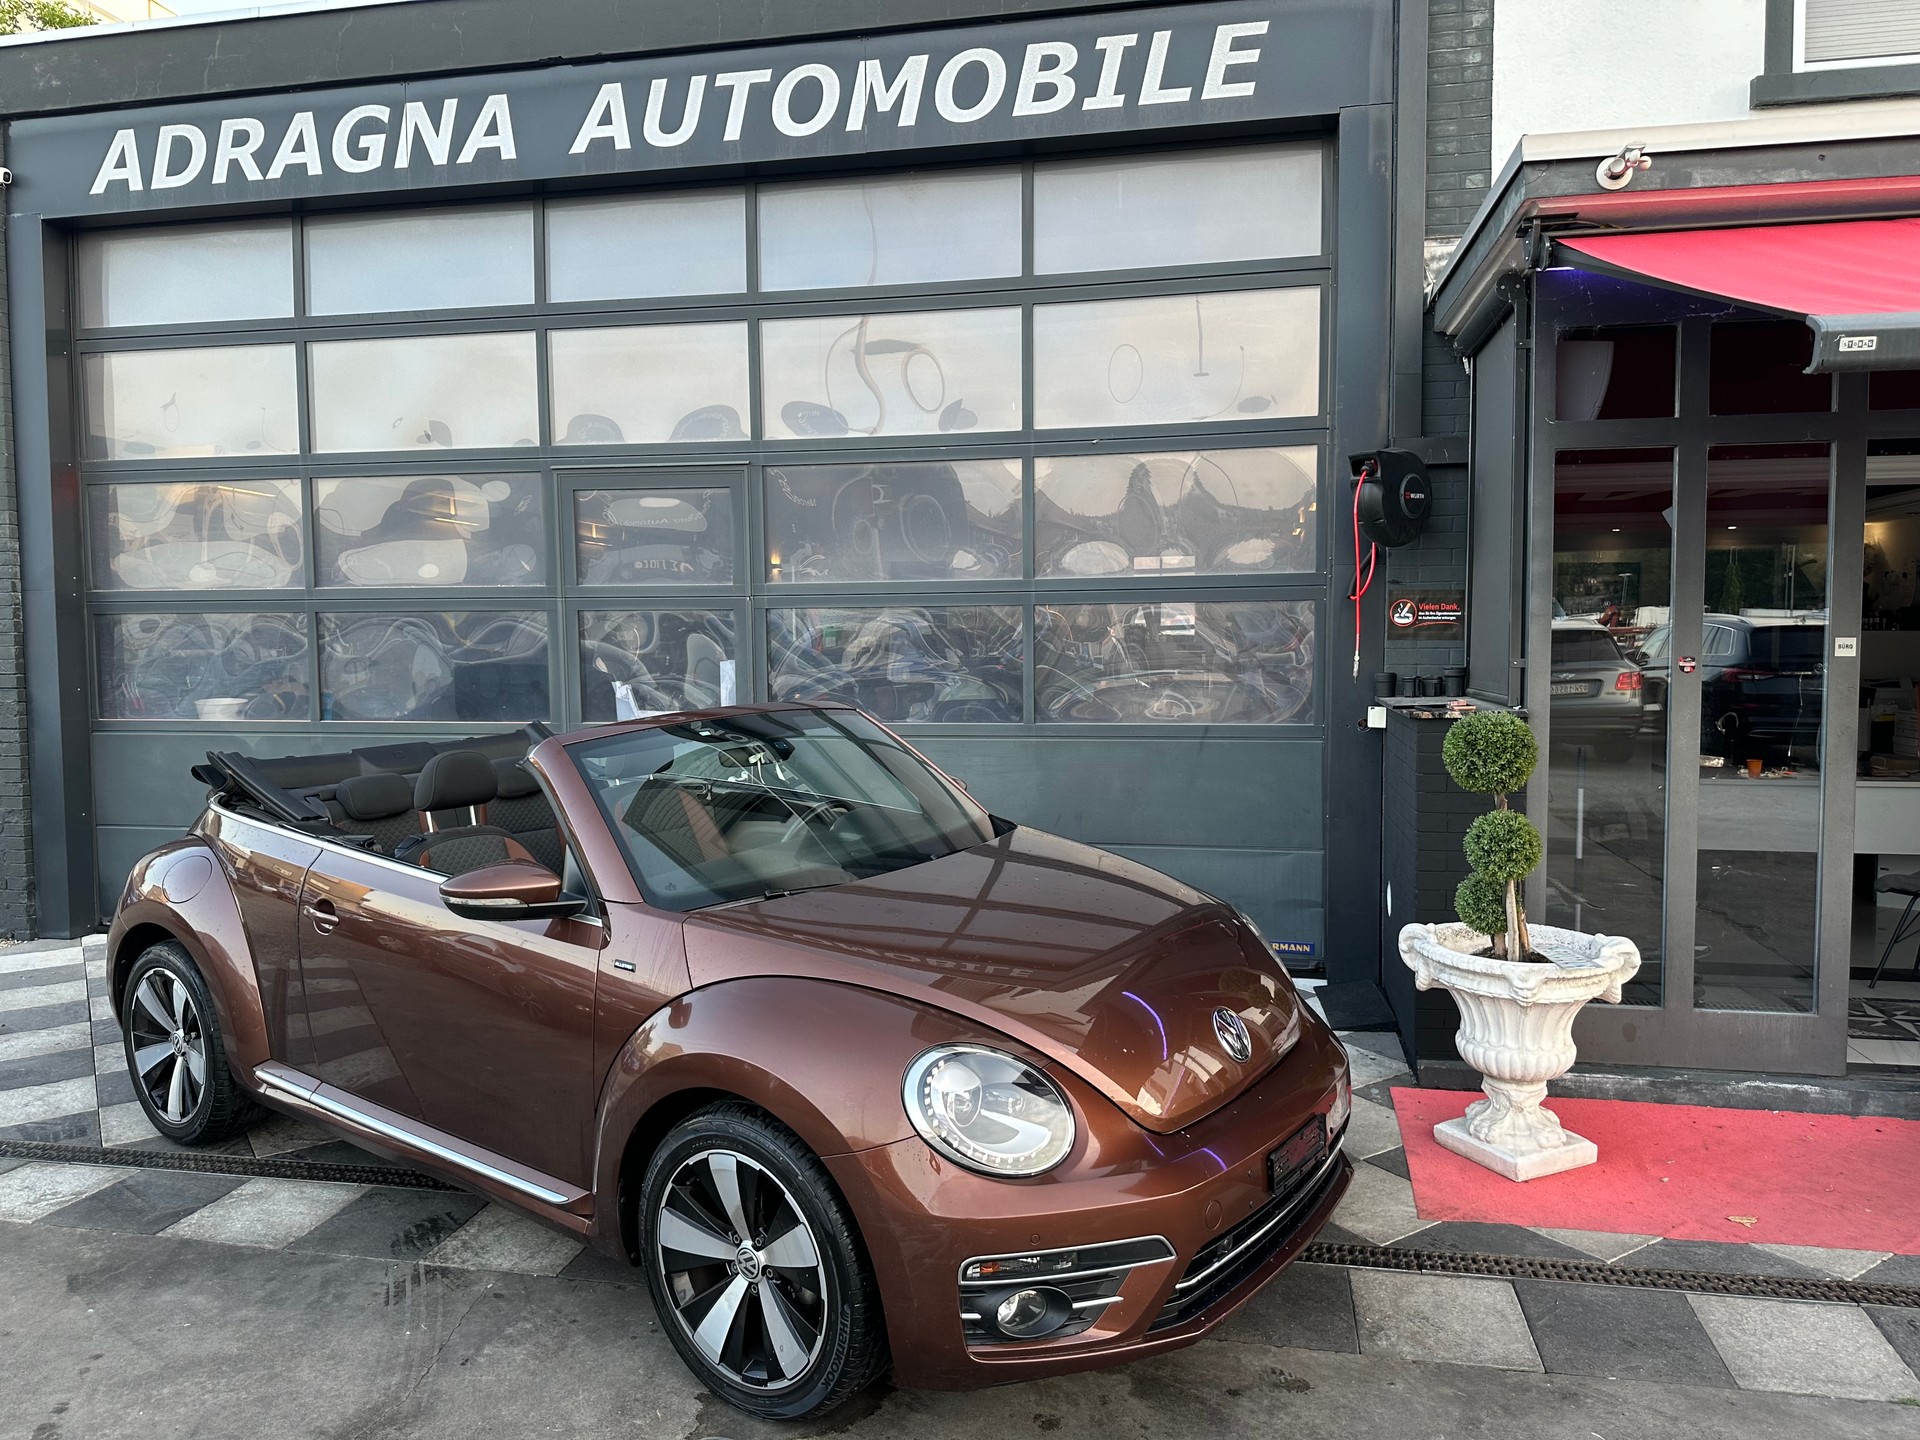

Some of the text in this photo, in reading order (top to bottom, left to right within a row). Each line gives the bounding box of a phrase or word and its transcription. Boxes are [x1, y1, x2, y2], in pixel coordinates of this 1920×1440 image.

[89, 20, 1270, 195] ADRAGNA AUTOMOBILE
[1271, 942, 1311, 952] RMANN
